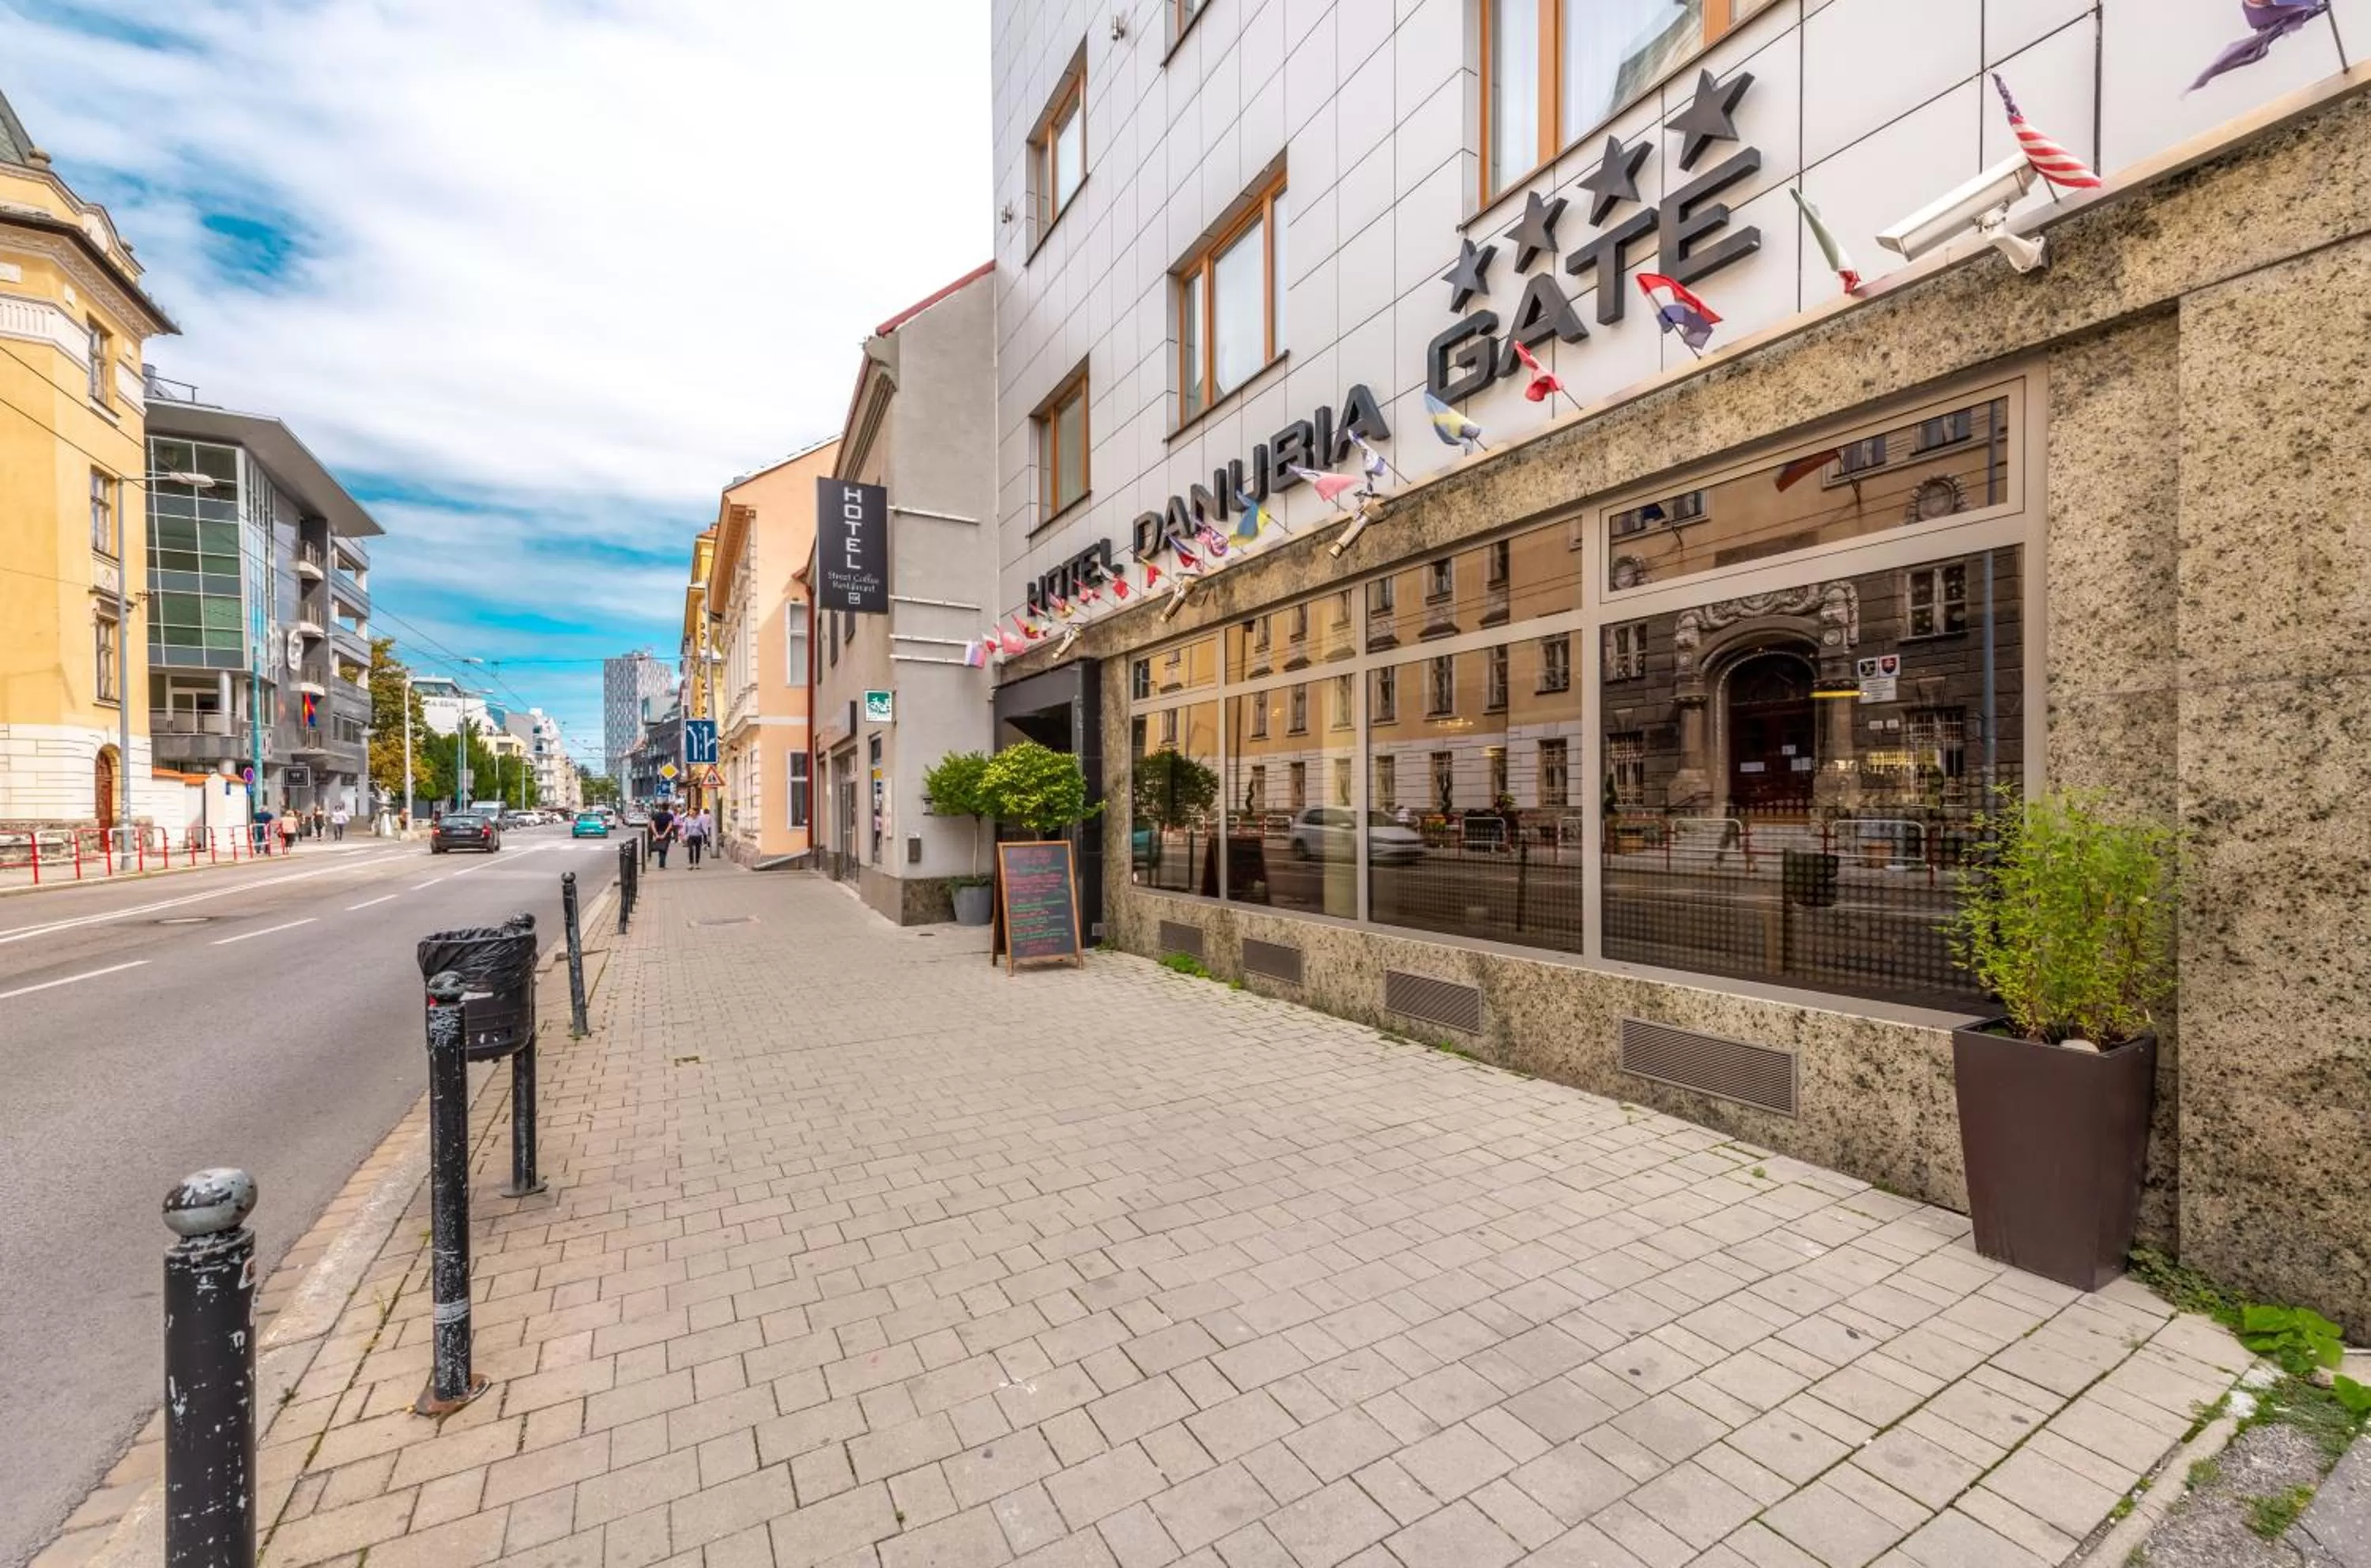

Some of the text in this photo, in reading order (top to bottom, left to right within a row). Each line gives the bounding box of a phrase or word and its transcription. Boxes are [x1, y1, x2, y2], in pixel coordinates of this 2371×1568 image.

[1027, 146, 1762, 617] HOTEL DANUBIA GATE
[843, 486, 862, 570] HOTEL
